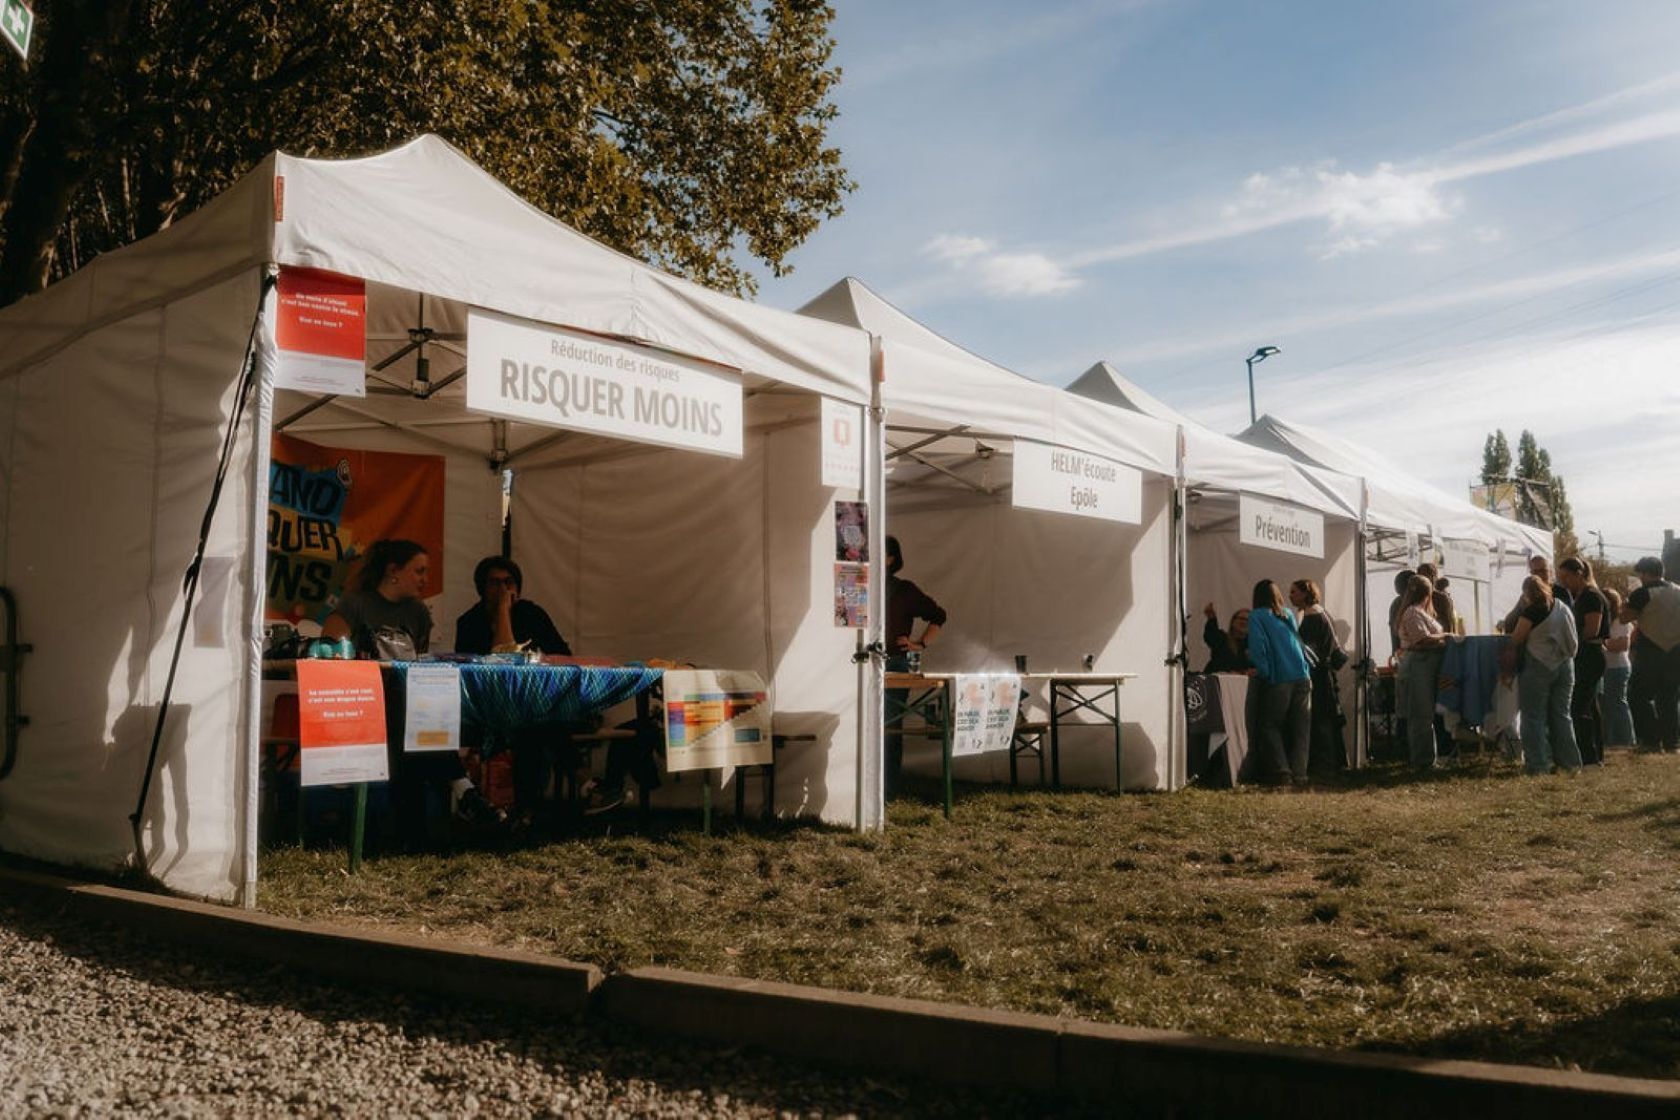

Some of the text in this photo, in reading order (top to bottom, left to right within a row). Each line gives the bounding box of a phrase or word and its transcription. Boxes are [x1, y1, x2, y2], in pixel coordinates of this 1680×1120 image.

[551, 339, 680, 383] Réduction des risques
[500, 357, 722, 438] RISQUER MOINS
[1255, 514, 1311, 549] Prévention
